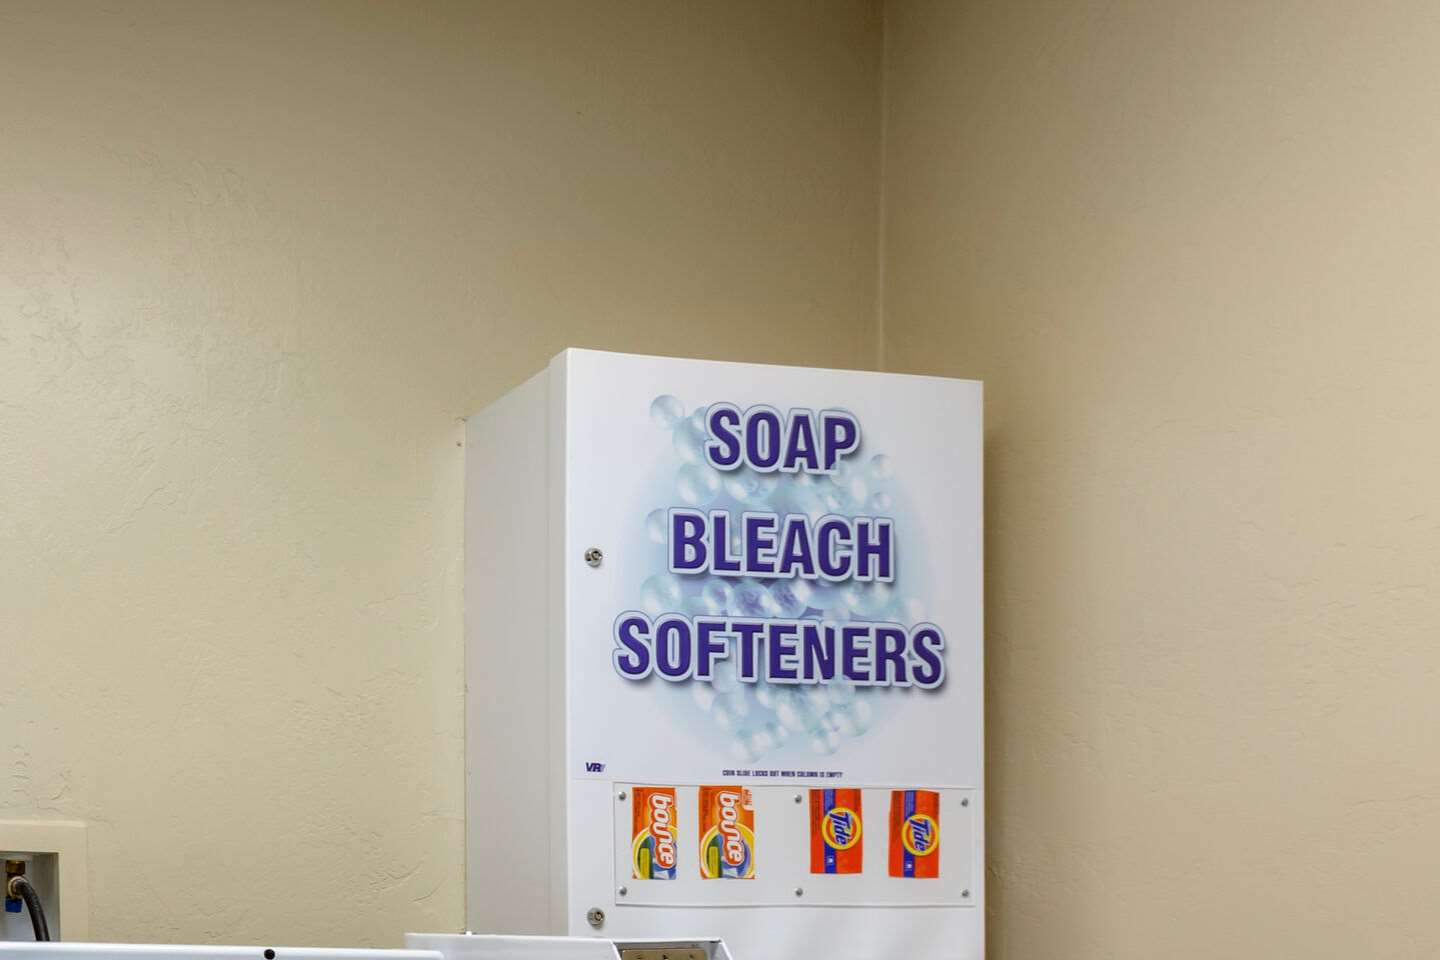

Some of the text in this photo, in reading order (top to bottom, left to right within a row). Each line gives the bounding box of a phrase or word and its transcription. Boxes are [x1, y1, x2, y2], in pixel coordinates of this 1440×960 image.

[706, 405, 858, 473] SOAP
[670, 510, 893, 580] BLEACH
[615, 613, 944, 688] SOFTENERS
[651, 793, 674, 865] bounce
[719, 792, 743, 862] bounce
[829, 811, 852, 845] Tide
[909, 818, 931, 852] Tide
